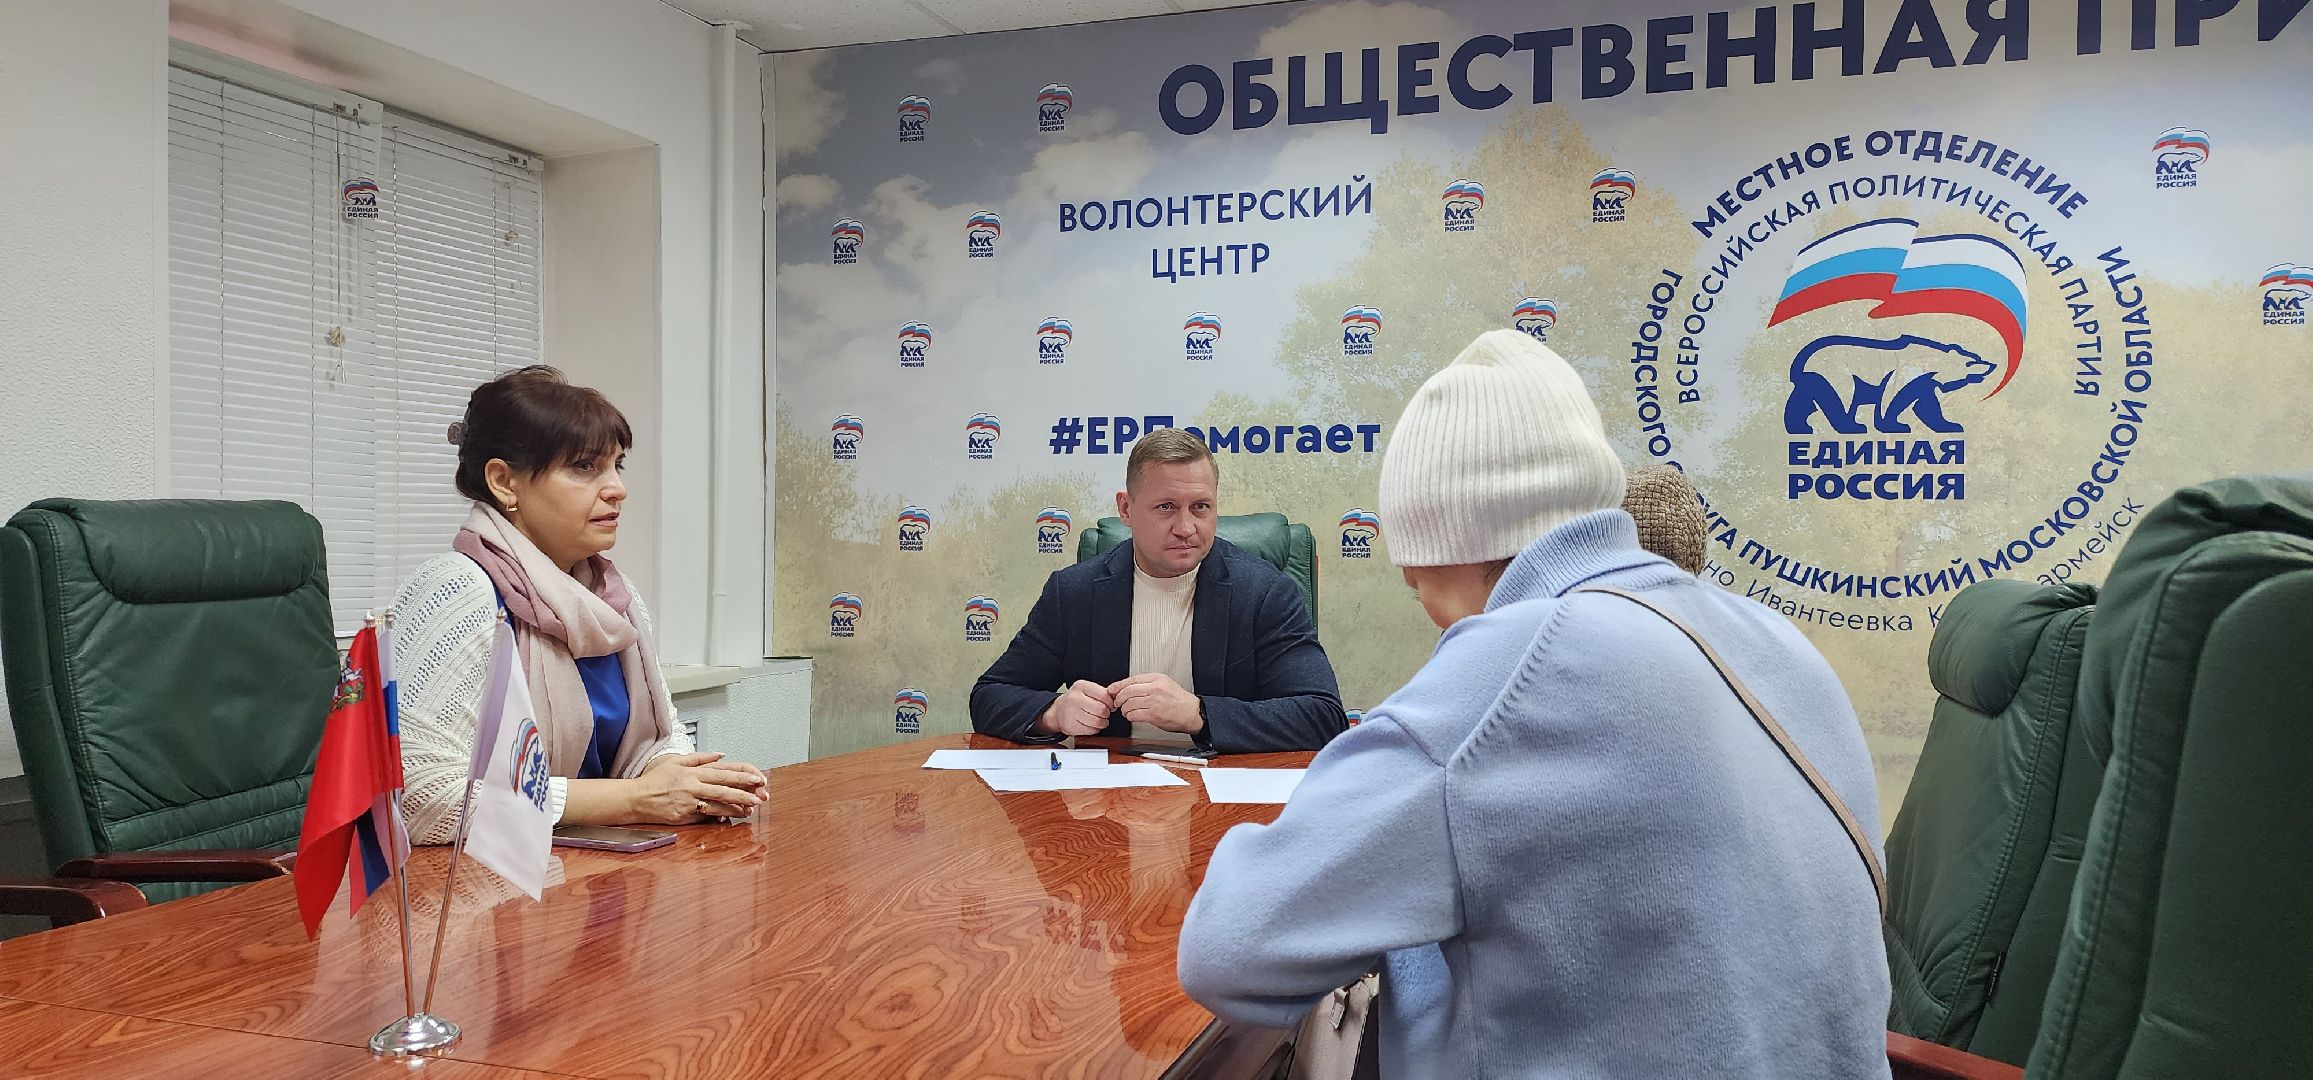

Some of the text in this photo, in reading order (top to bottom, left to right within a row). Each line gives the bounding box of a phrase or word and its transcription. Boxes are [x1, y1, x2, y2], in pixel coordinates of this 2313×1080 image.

[1159, 0, 2029, 135] ОБЩЕСТВЕННАЯ
[1060, 175, 1372, 232] ВОЛОНТЕРСКИЙ
[1691, 130, 2088, 239] МЕСТНОЕ ОТДЕЛЕНИЕ
[2157, 181, 2197, 189] РОССИЯ
[1152, 243, 1271, 284] ЦЕНТР
[1676, 174, 2102, 404] ВСЕРОССИЙСКАЯ ПОЛИТИЧЕСКАЯ ПАРТИЯ
[1631, 268, 1683, 457] ГОРОДСКОГО
[1739, 539, 1975, 598] ПУШКИНСКИЙ
[1978, 399, 2148, 578] МОСКОВСКОЙ
[2097, 246, 2153, 392] ОБЛАСТИ
[1788, 440, 1965, 468] ЕДИНАЯ
[1788, 473, 1965, 500] РОССИЯ
[1746, 579, 1913, 631] Ивантеевка
